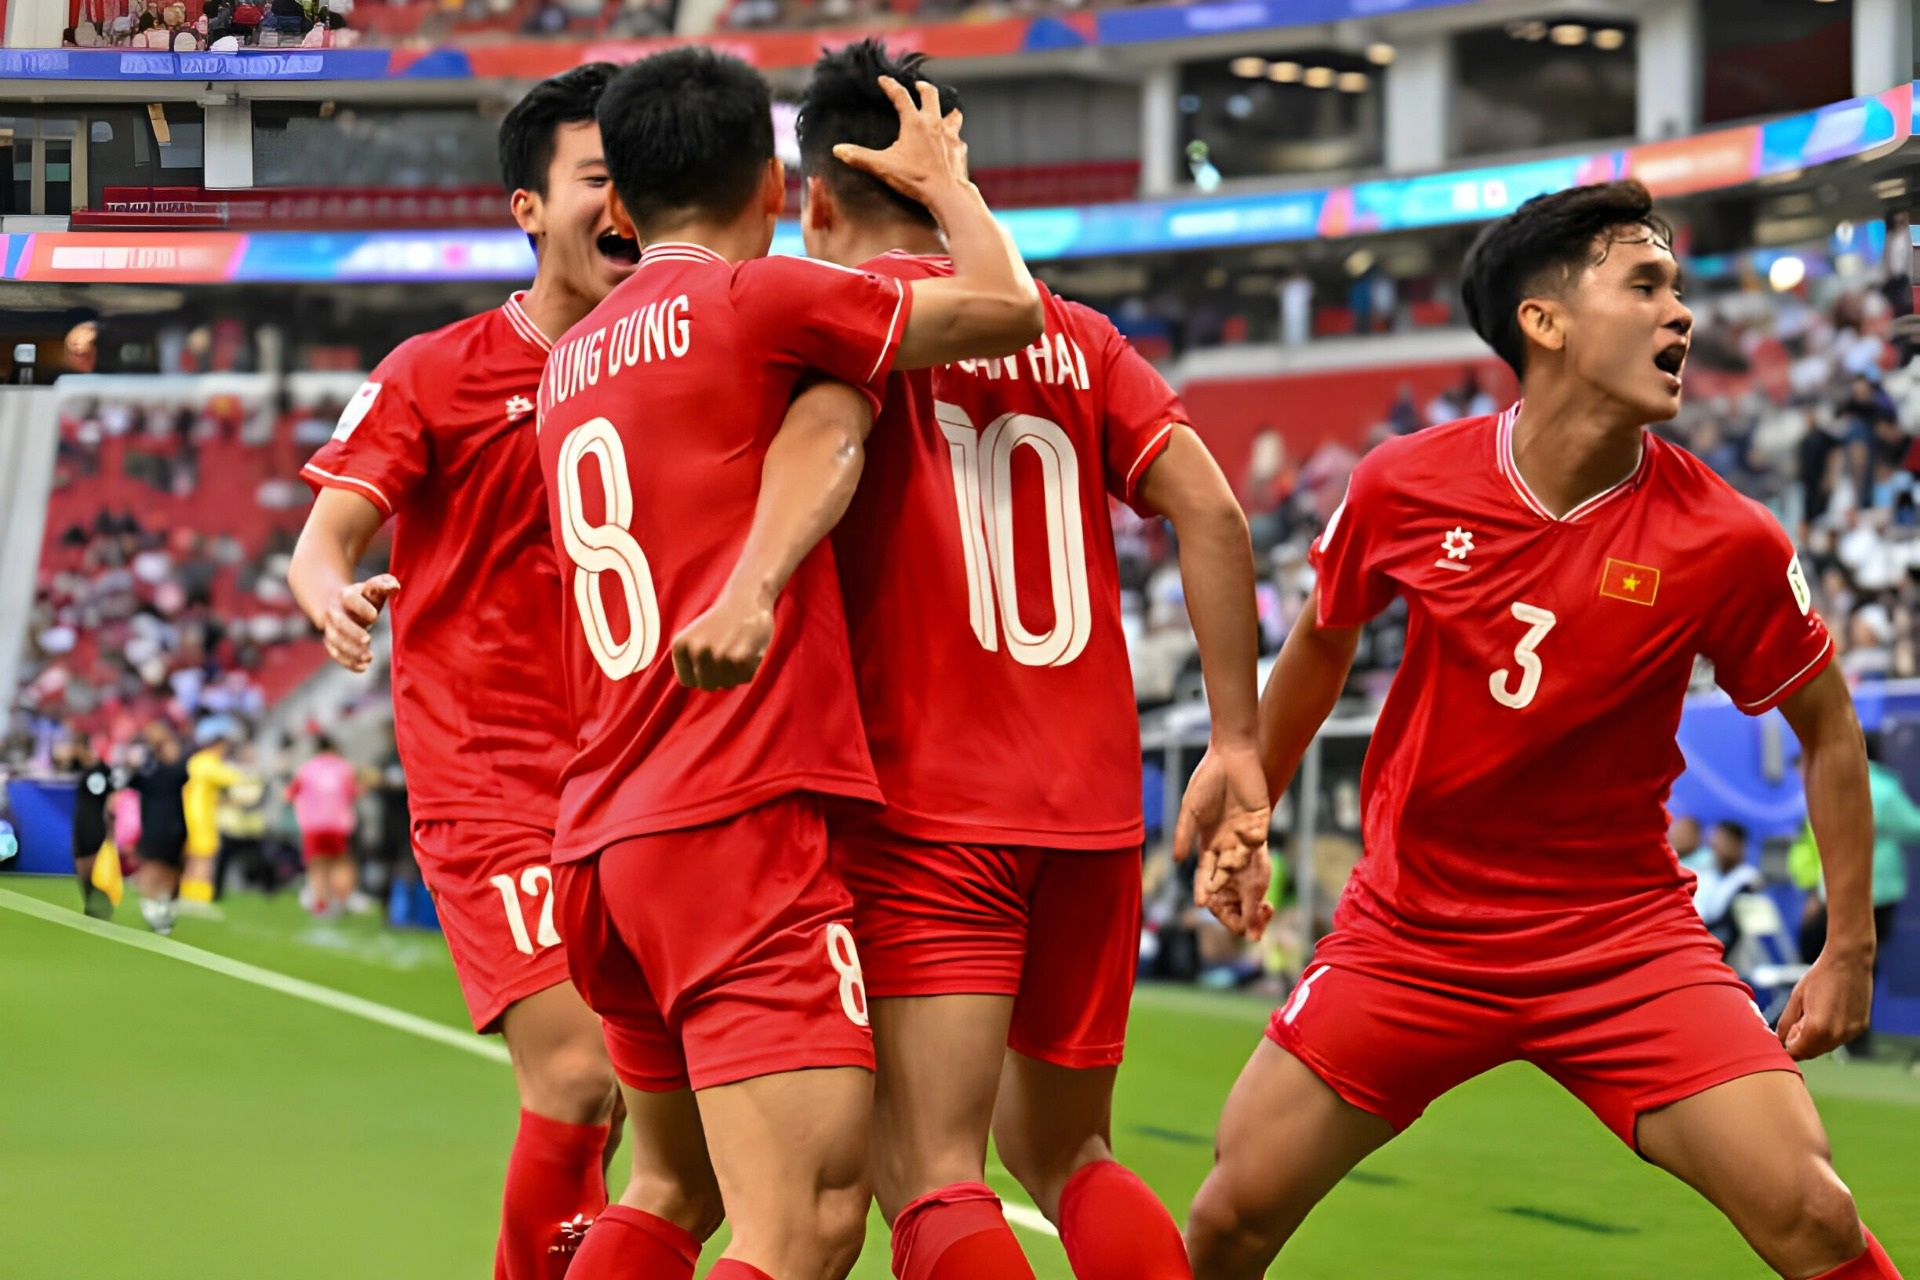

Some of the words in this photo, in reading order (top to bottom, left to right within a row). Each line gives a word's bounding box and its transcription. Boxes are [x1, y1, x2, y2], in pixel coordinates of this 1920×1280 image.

[1026, 332, 1090, 390] HAI
[557, 416, 661, 681] 8
[934, 400, 1092, 667] 10
[1489, 601, 1557, 709] 3
[489, 866, 562, 955] 12
[826, 923, 869, 1027] 8
